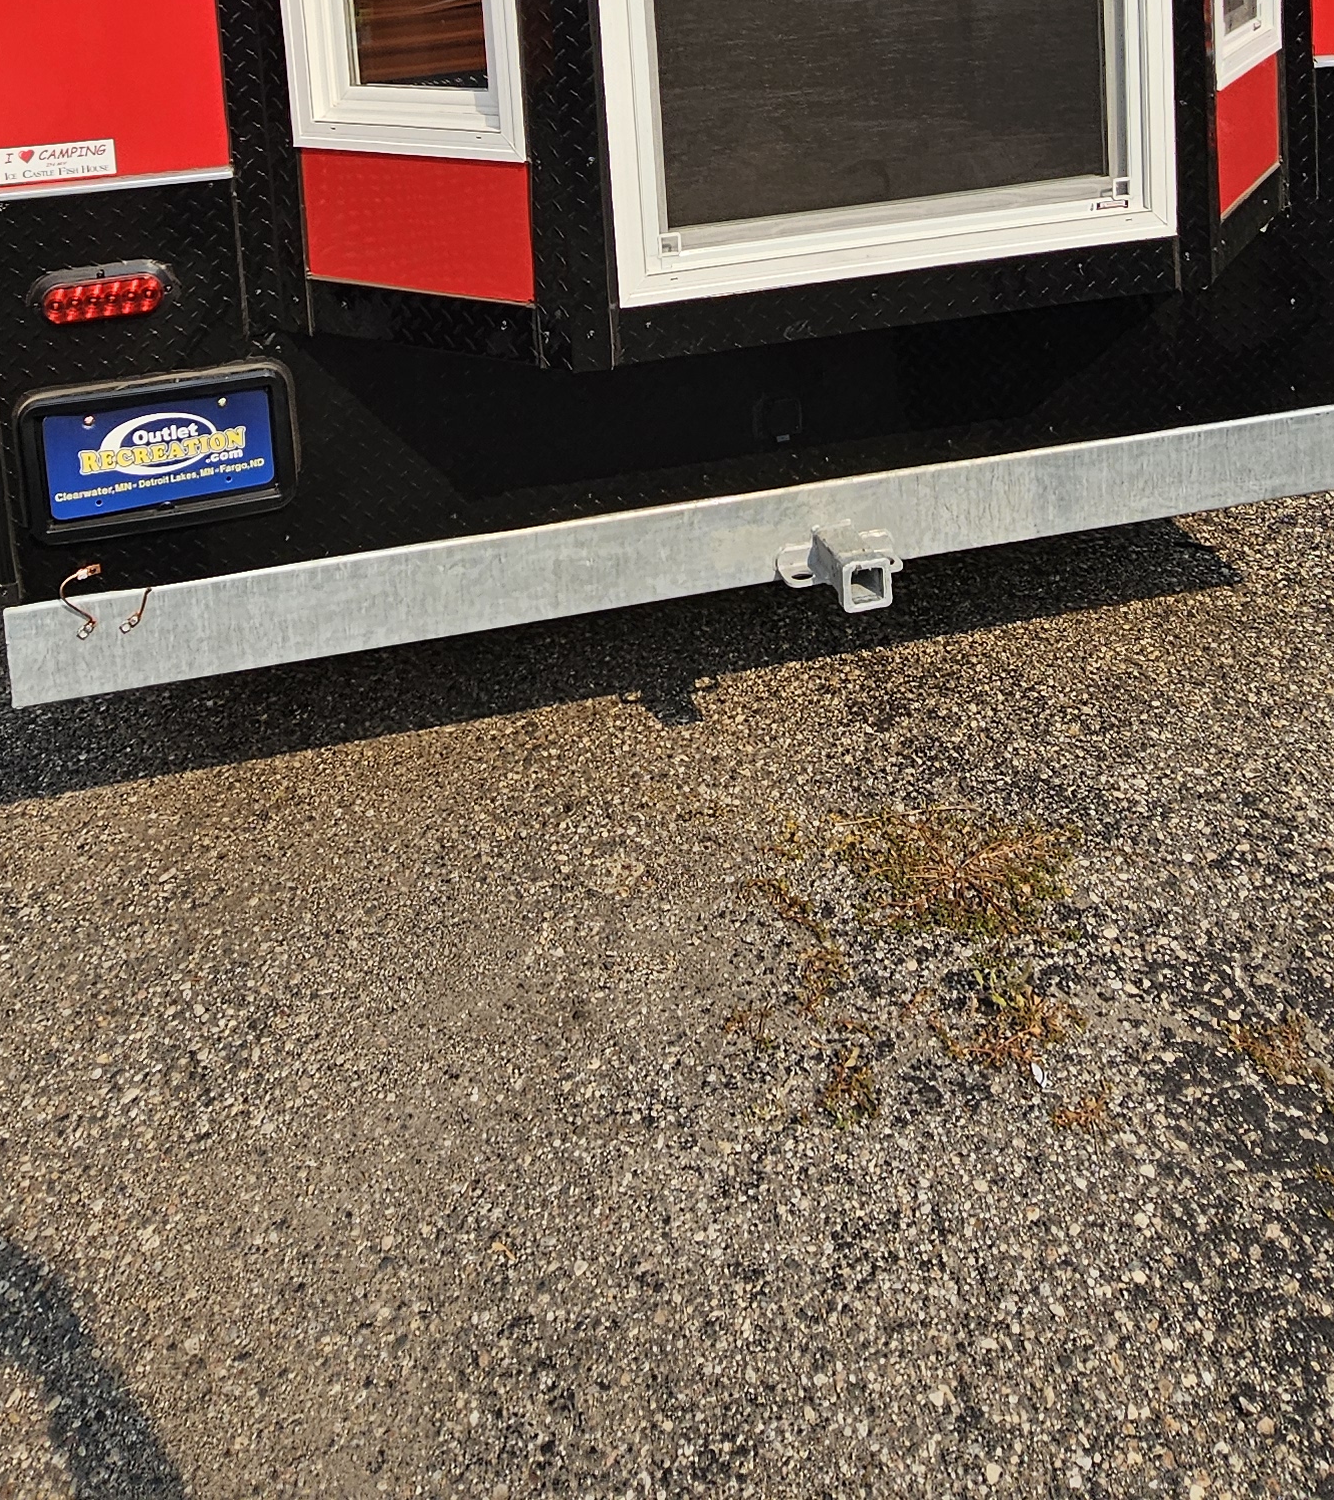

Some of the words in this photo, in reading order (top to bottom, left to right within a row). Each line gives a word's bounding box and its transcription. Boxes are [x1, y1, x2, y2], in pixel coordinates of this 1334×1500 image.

[5, 153, 14, 164] I
[38, 144, 106, 161] CAMPING
[22, 169, 55, 179] CASTLE
[132, 422, 199, 445] Outlet
[79, 427, 246, 475] RECREATION
[205, 449, 244, 464] .com
[138, 475, 169, 488] Detroit
